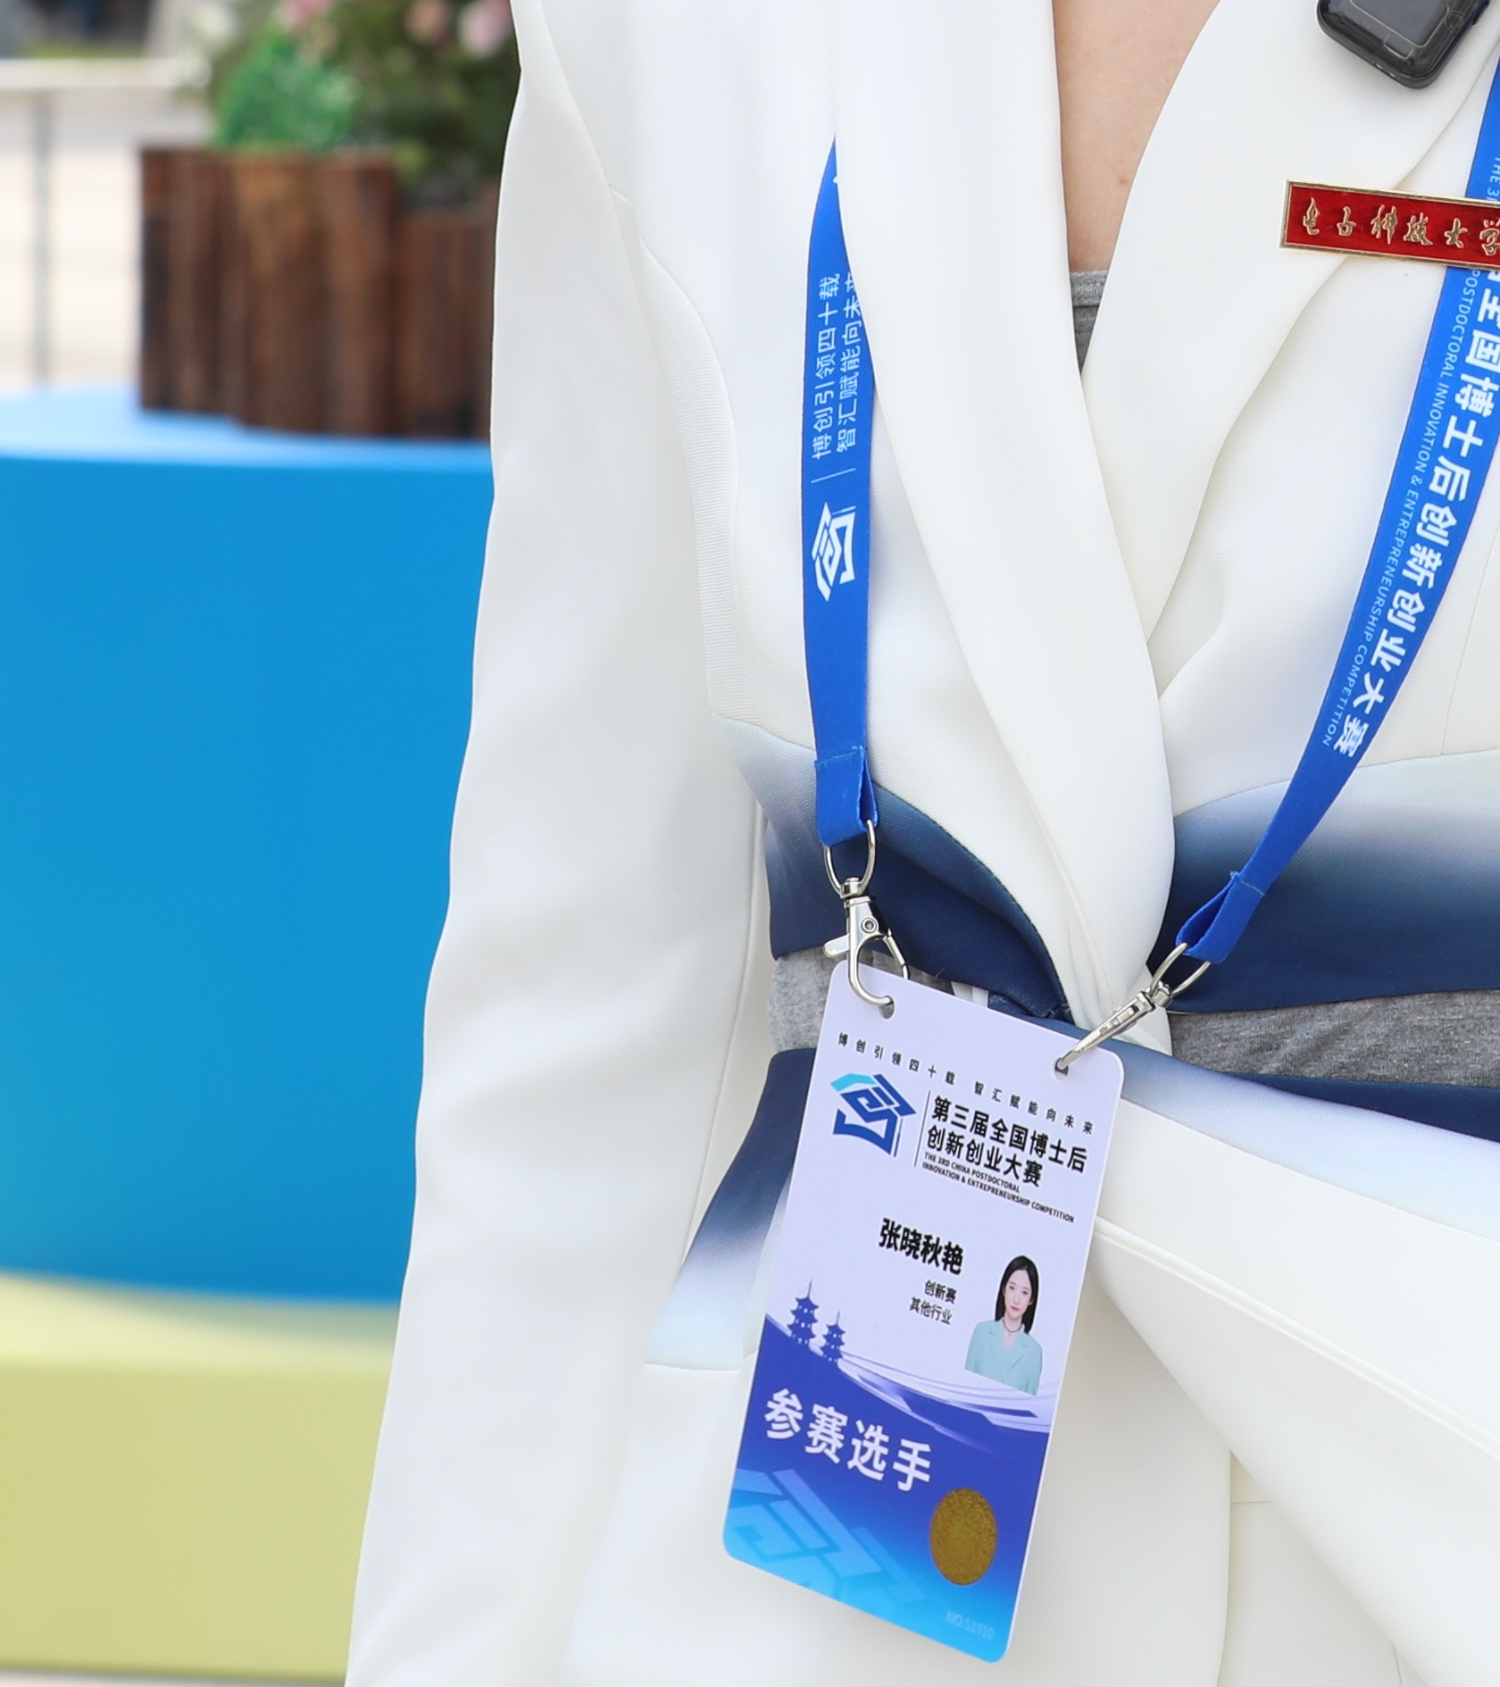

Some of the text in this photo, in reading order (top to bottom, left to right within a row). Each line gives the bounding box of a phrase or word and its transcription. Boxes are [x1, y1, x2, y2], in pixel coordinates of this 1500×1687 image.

[811, 272, 841, 461] 博创引领四十载
[1413, 381, 1450, 474] INNOVATION
[1409, 474, 1424, 487] &
[1364, 490, 1420, 642] ENTREPRENEURSHIP
[1322, 643, 1369, 747] COMPETITION
[838, 1032, 1094, 1135] 博创引领四十载 智汇赋能向未来
[926, 1124, 1043, 1187] 创新创业大赛
[931, 1095, 1088, 1173] 第三届全国博士后
[922, 1161, 961, 1183] INNOVATION
[967, 1178, 1031, 1208] ENTREPRENEURSHIP
[1031, 1200, 1075, 1224] COMPETITION
[924, 1152, 1021, 1194] THE 3RD CHINA POSTDOCTORAL
[878, 1216, 964, 1276] 张晓秋艳
[909, 1296, 953, 1326] 其他行业
[924, 1279, 958, 1305] 创新赛
[764, 1388, 932, 1492] 参赛选手
